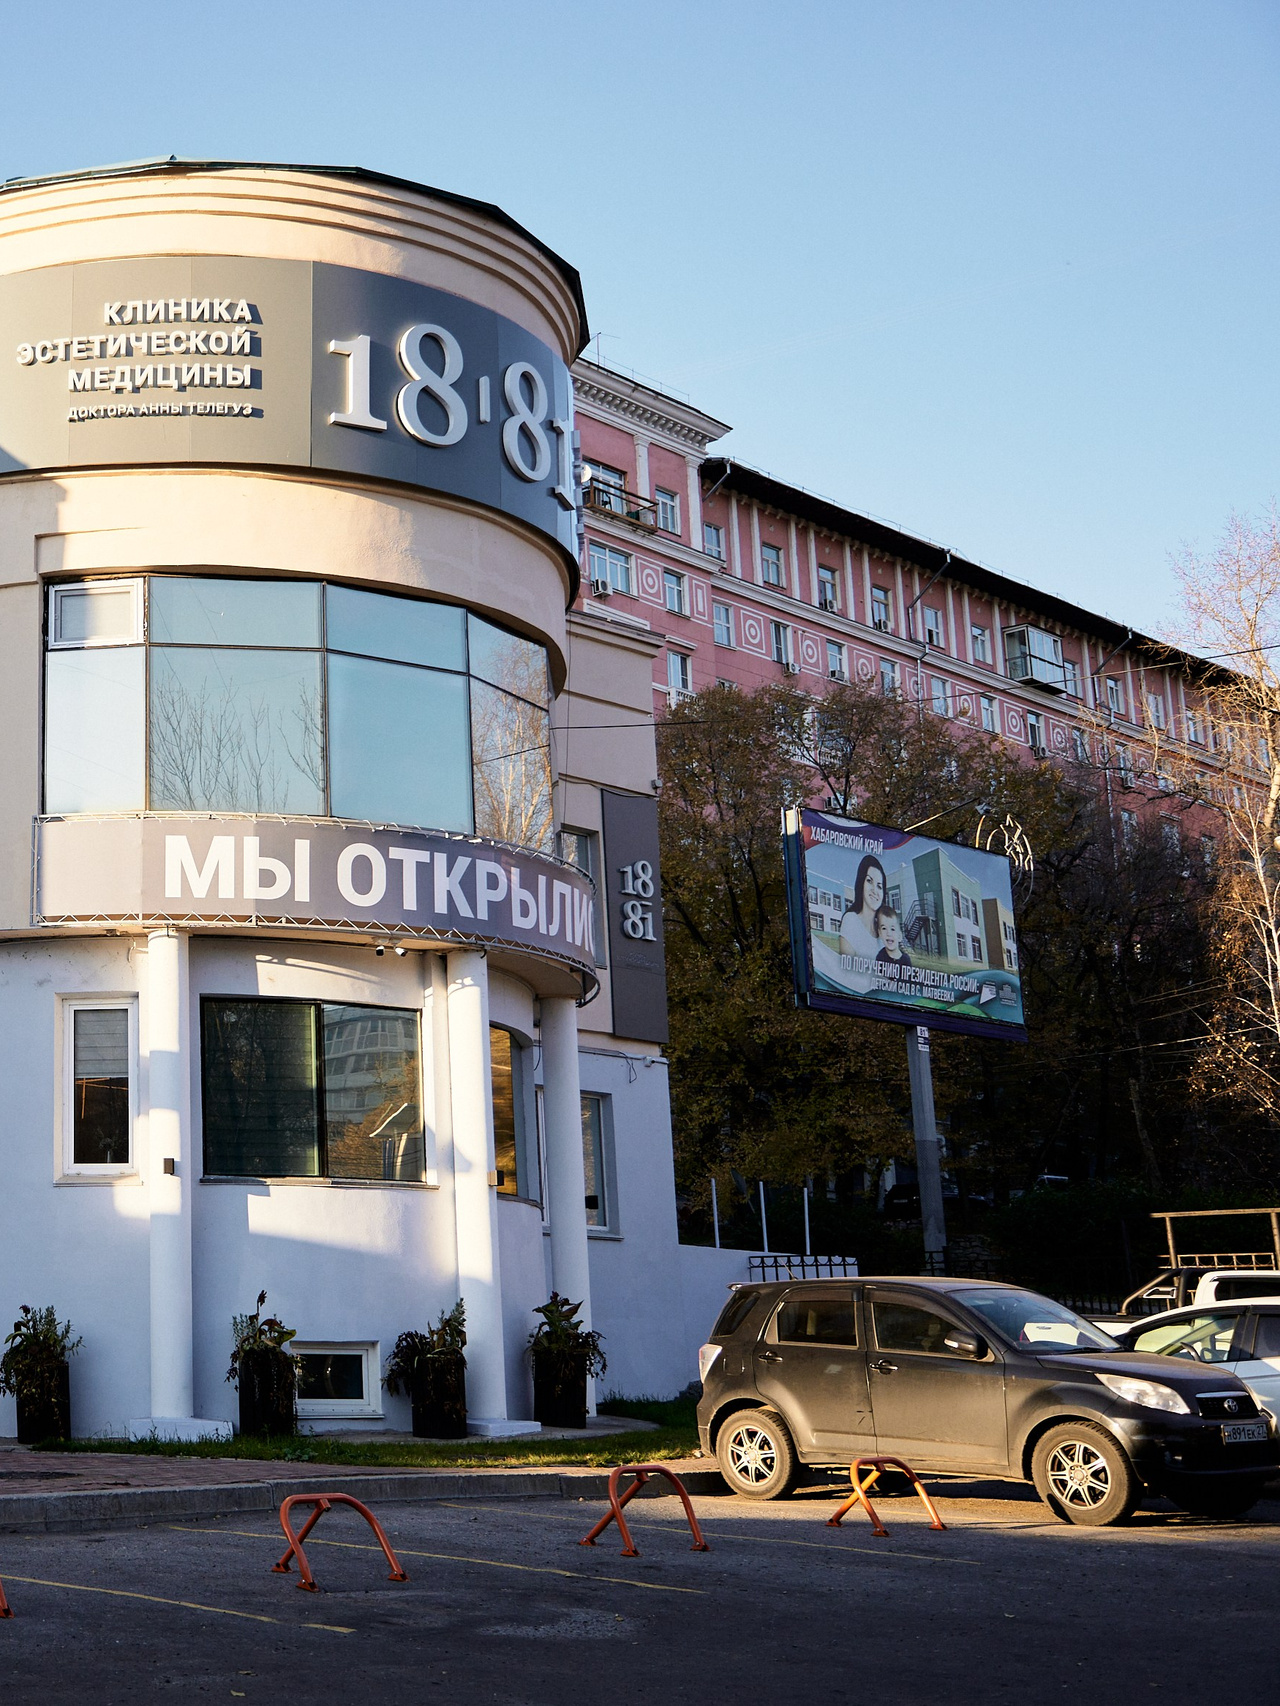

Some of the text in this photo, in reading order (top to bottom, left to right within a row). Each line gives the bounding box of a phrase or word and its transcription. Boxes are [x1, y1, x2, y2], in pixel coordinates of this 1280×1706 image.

[104, 298, 252, 325] КЛИНИКА
[16, 326, 251, 366] ЭСТЕТИЧЕСКОЙ
[68, 363, 252, 393] МЕДИЦИНЫ
[68, 402, 253, 421] ДОКТОРА АННЫ ТЕЛЕГУЗ
[810, 825, 883, 855] ХАБАРОВСКИЙ КРАЙ
[164, 834, 311, 903] МЫ
[619, 860, 654, 898] 18
[623, 900, 657, 941] 81
[841, 954, 852, 970] ПО
[853, 956, 900, 979] ПОРУЧЕНИЮ
[901, 965, 948, 987] ПРЕЗИДЕНТА
[949, 974, 980, 993] РОССИИ:
[871, 978, 898, 992] ДЕТСКИЙ
[898, 981, 910, 996] САД
[922, 986, 955, 1003] МАТВЕЕВКА
